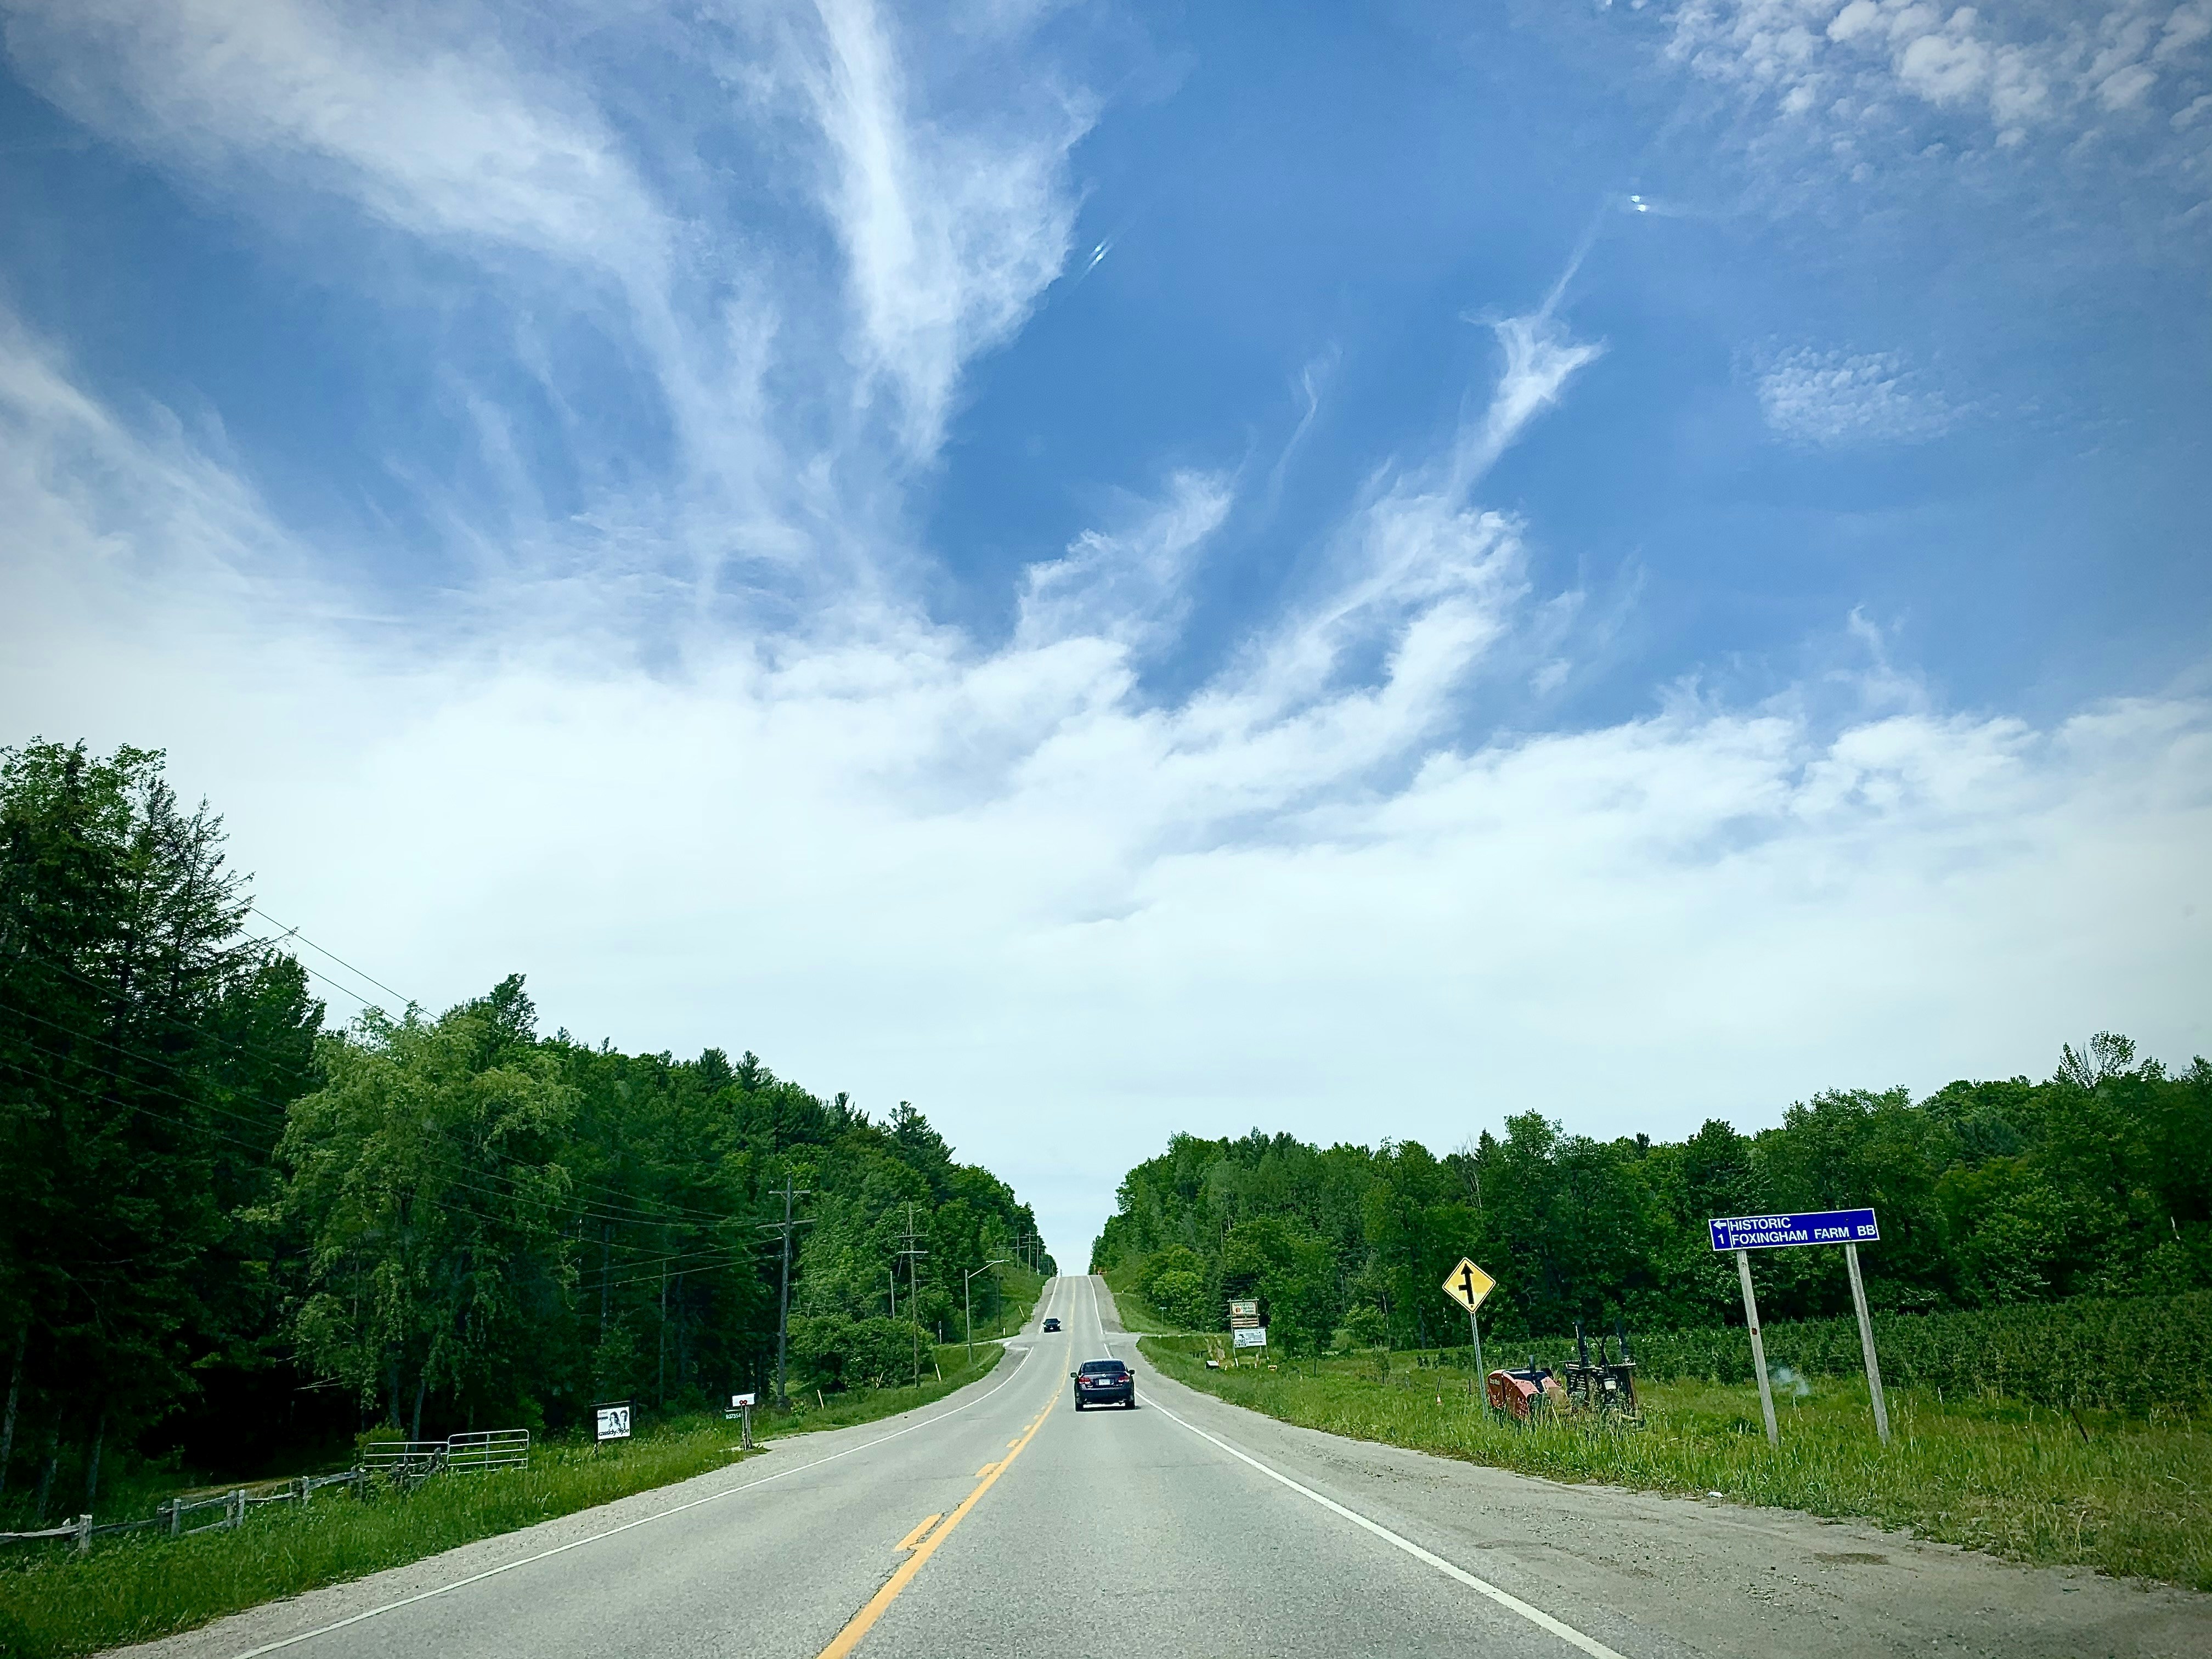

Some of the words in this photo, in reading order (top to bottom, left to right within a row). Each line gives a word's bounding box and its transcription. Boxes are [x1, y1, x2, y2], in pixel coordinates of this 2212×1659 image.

[1730, 1217, 1791, 1231] HISTORIC
[1718, 1234, 1724, 1244] 1
[1731, 1230, 1808, 1245] FOXINGHAM
[1814, 1227, 1849, 1239] FARM
[1857, 1224, 1876, 1237] BB
